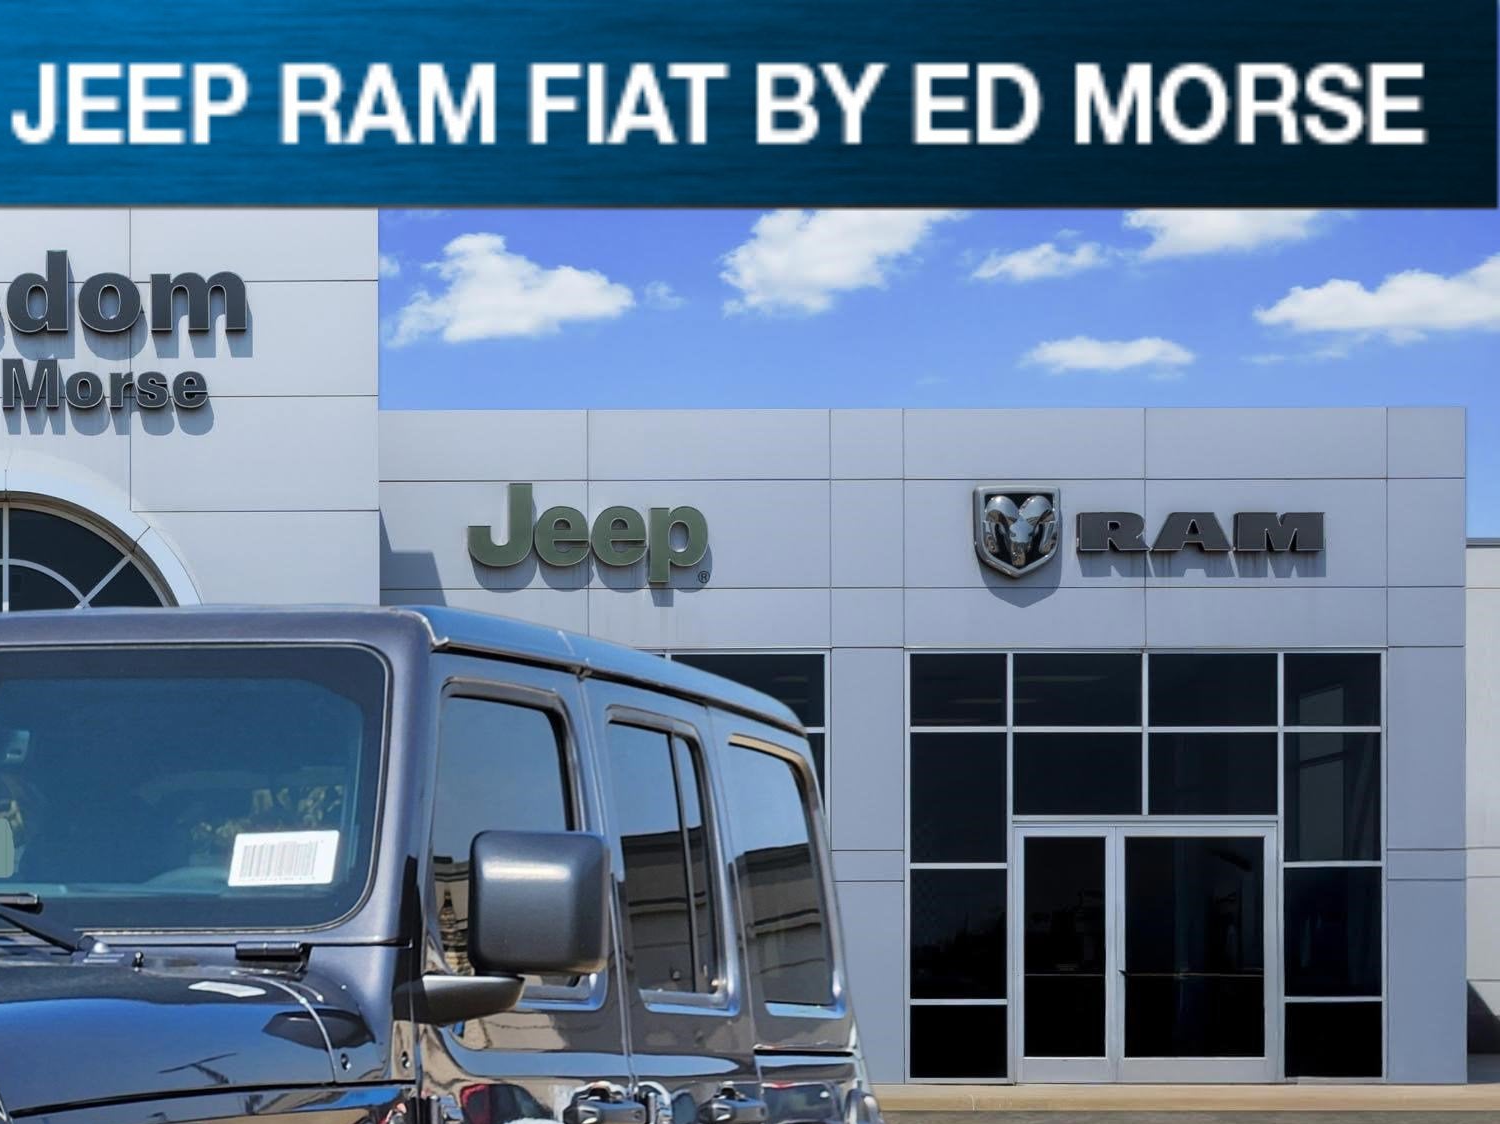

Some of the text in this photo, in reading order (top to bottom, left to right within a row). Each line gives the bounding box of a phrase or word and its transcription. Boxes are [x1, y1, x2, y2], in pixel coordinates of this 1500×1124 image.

[2, 357, 209, 409] Morse
[466, 482, 709, 584] Jeep
[1076, 511, 1326, 553] RAM
